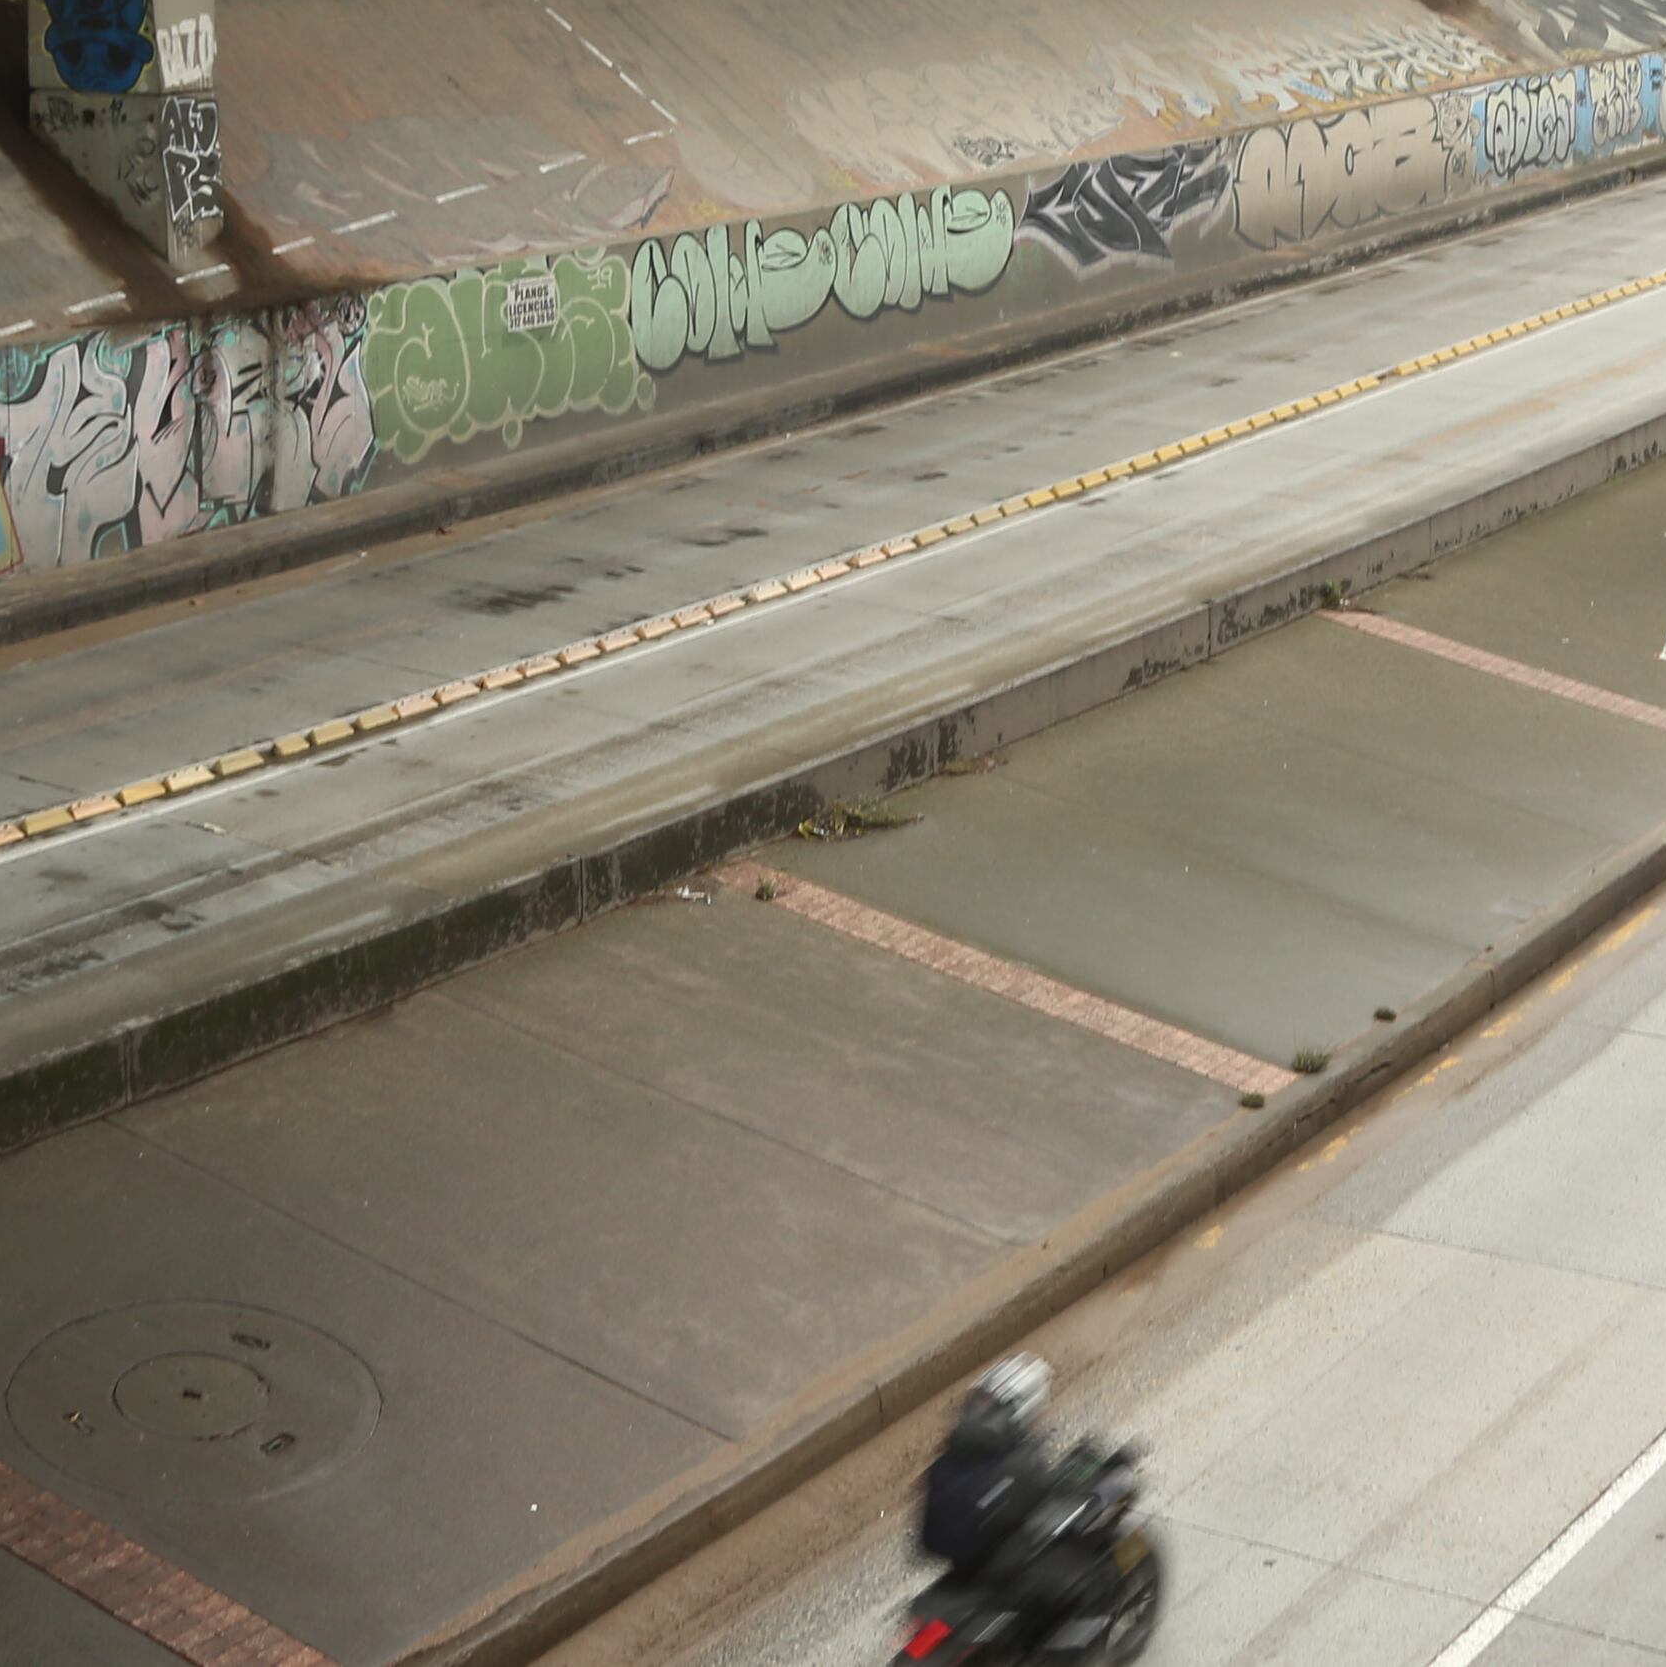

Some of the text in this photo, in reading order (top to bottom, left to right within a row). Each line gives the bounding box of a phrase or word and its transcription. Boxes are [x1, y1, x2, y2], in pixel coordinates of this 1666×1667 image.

[156, 13, 217, 89] BAZO
[514, 285, 549, 302] PLANOS
[509, 298, 554, 316] LICENCIAS
